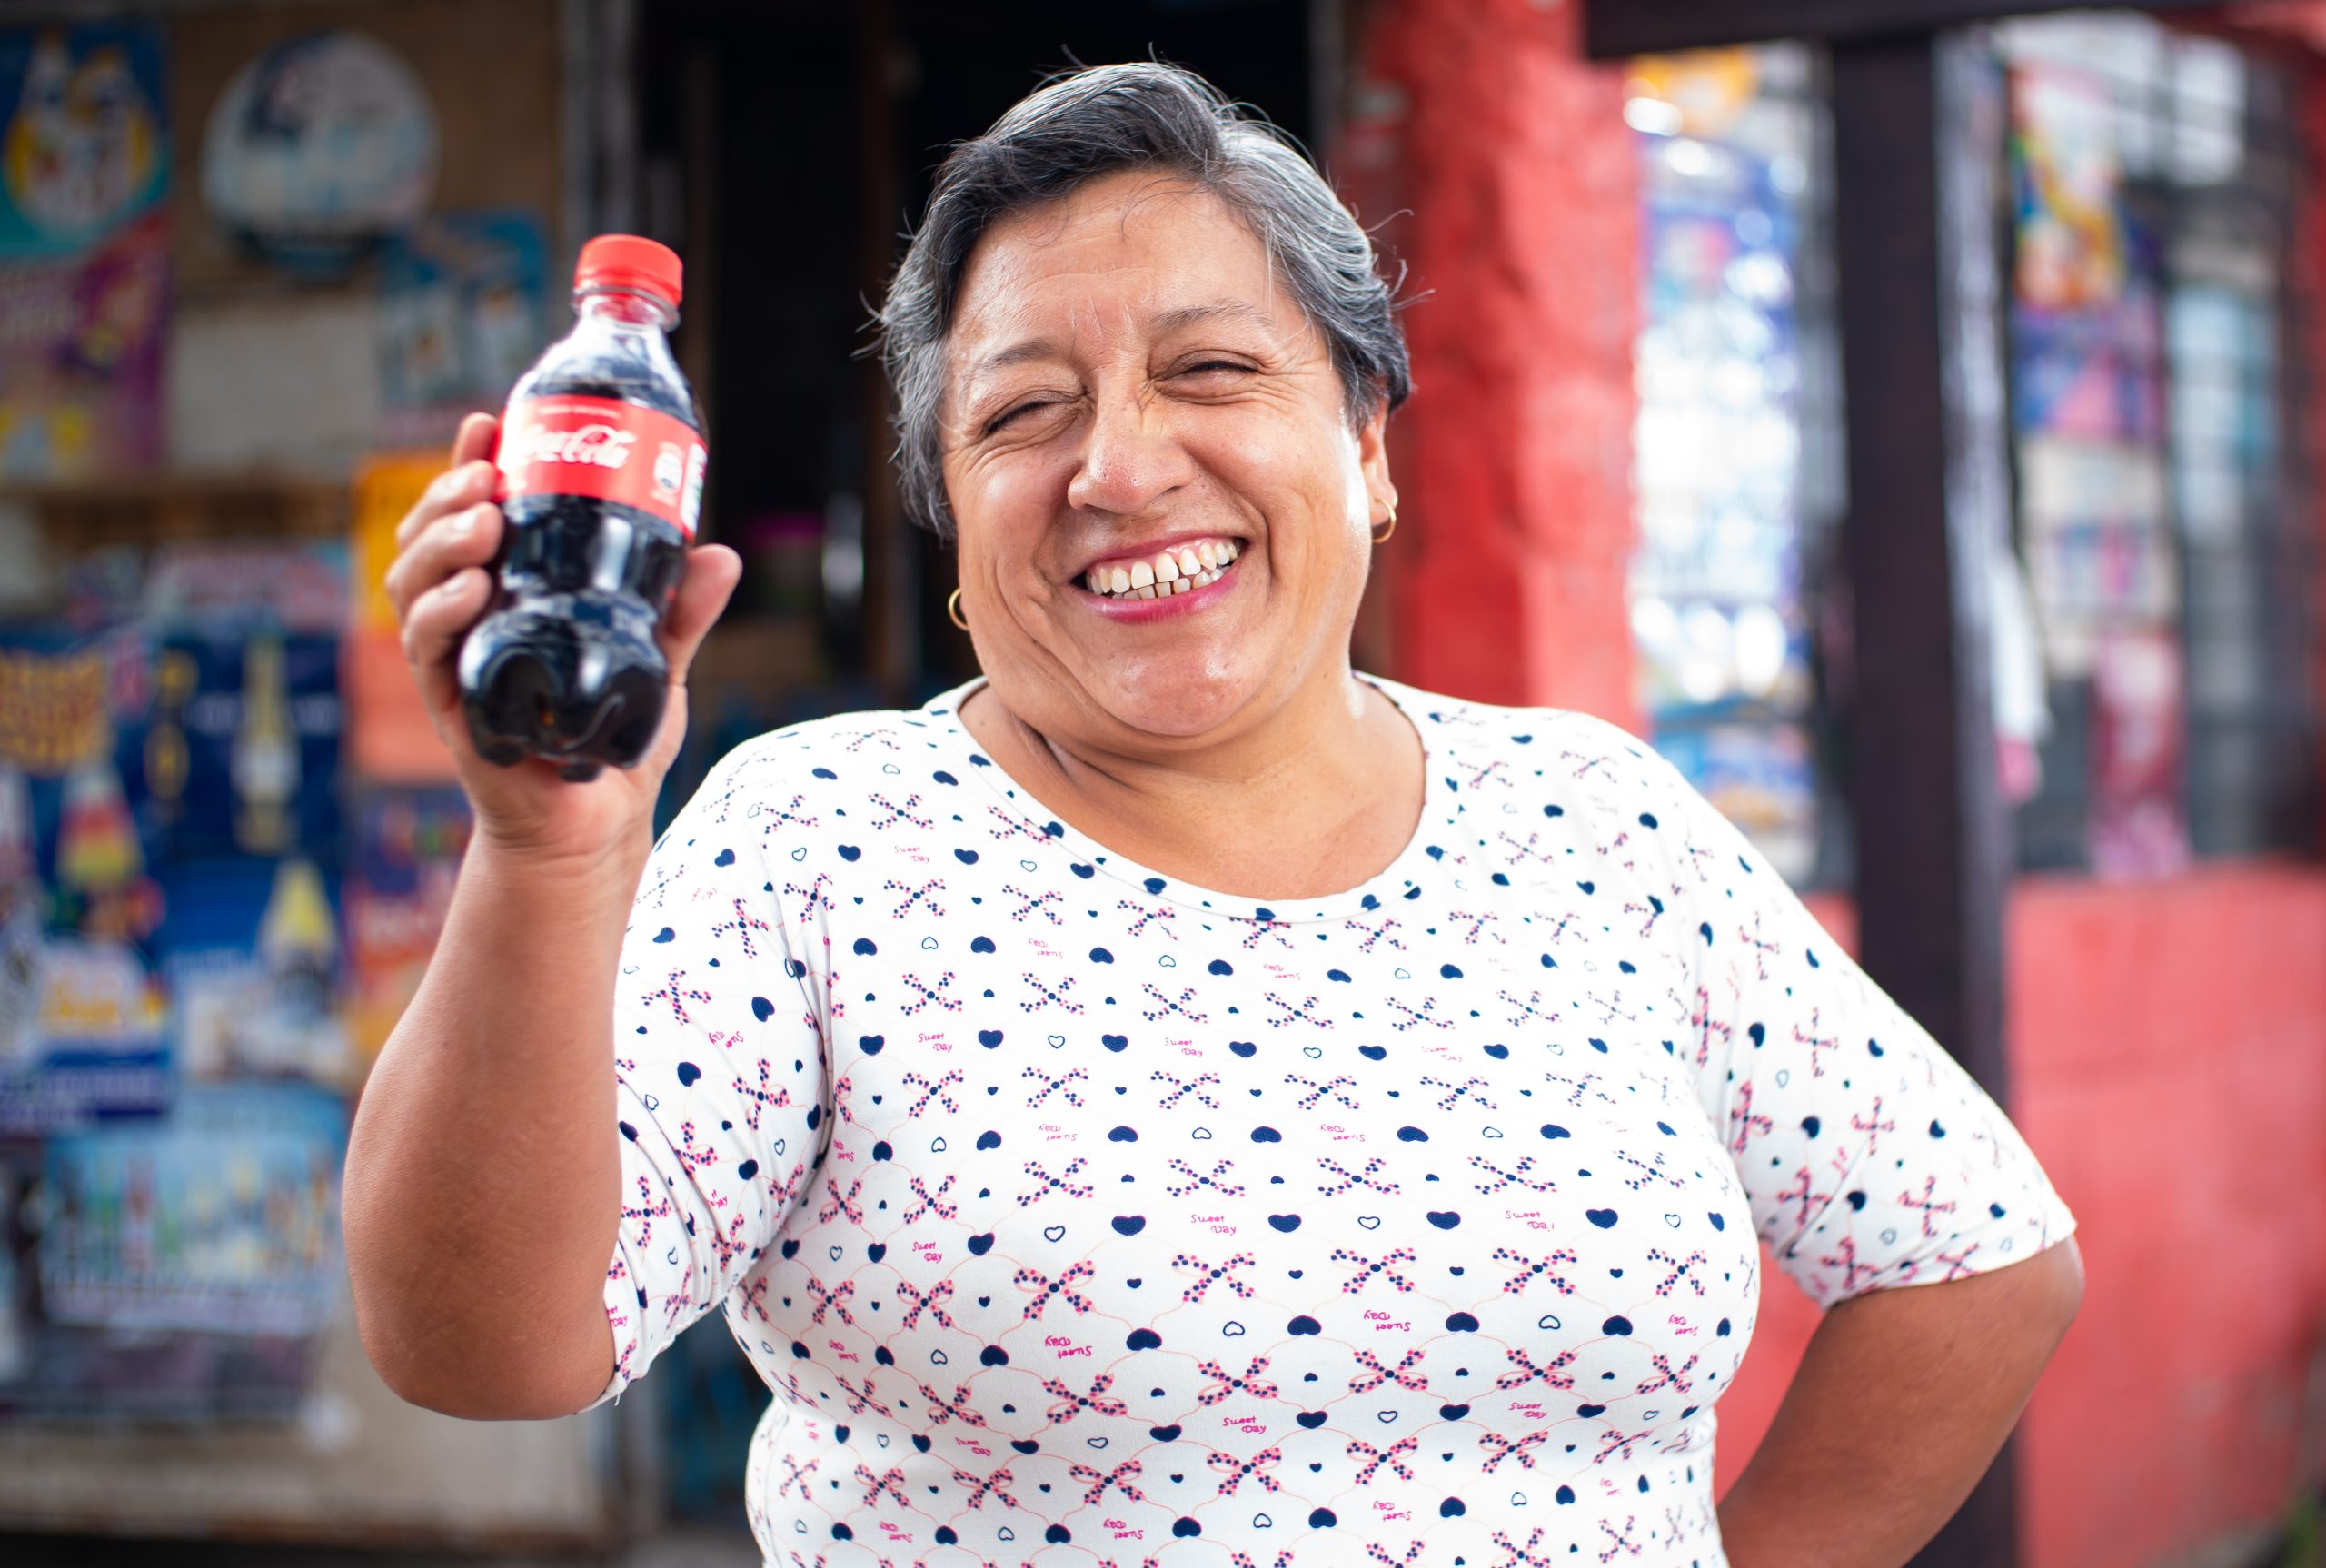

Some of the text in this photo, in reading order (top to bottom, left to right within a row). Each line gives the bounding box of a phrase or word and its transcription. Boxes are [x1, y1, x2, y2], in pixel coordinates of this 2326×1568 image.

[894, 844, 920, 854] Sweet
[910, 854, 931, 863] Day
[1027, 938, 1047, 948] Day
[1037, 950, 1062, 959] Sweet
[1263, 963, 1284, 973] Day
[919, 1032, 945, 1043] Sweet
[1166, 1037, 1192, 1046] Sweet
[933, 1042, 952, 1051] Day
[1182, 1048, 1203, 1057] Day
[1319, 1125, 1344, 1133] Day
[1332, 1134, 1366, 1142] Sweet
[1192, 1214, 1225, 1223] Sweet
[1211, 1226, 1237, 1235] Day
[912, 1241, 937, 1251] Sweet
[923, 1252, 943, 1264] Day
[1363, 1310, 1392, 1321] Day
[1375, 1322, 1410, 1332] Sweet
[1043, 1335, 1072, 1347] Day
[1057, 1345, 1092, 1359] Sweet
[1508, 1402, 1542, 1410] Sweet
[1523, 1410, 1547, 1419] Day
[1223, 1415, 1257, 1427] Sweet
[1241, 1424, 1267, 1434] Day
[1373, 1501, 1395, 1512] Day
[1382, 1511, 1411, 1522] Sweet
[1102, 1517, 1127, 1530] Day
[1113, 1528, 1144, 1540] Sweet
